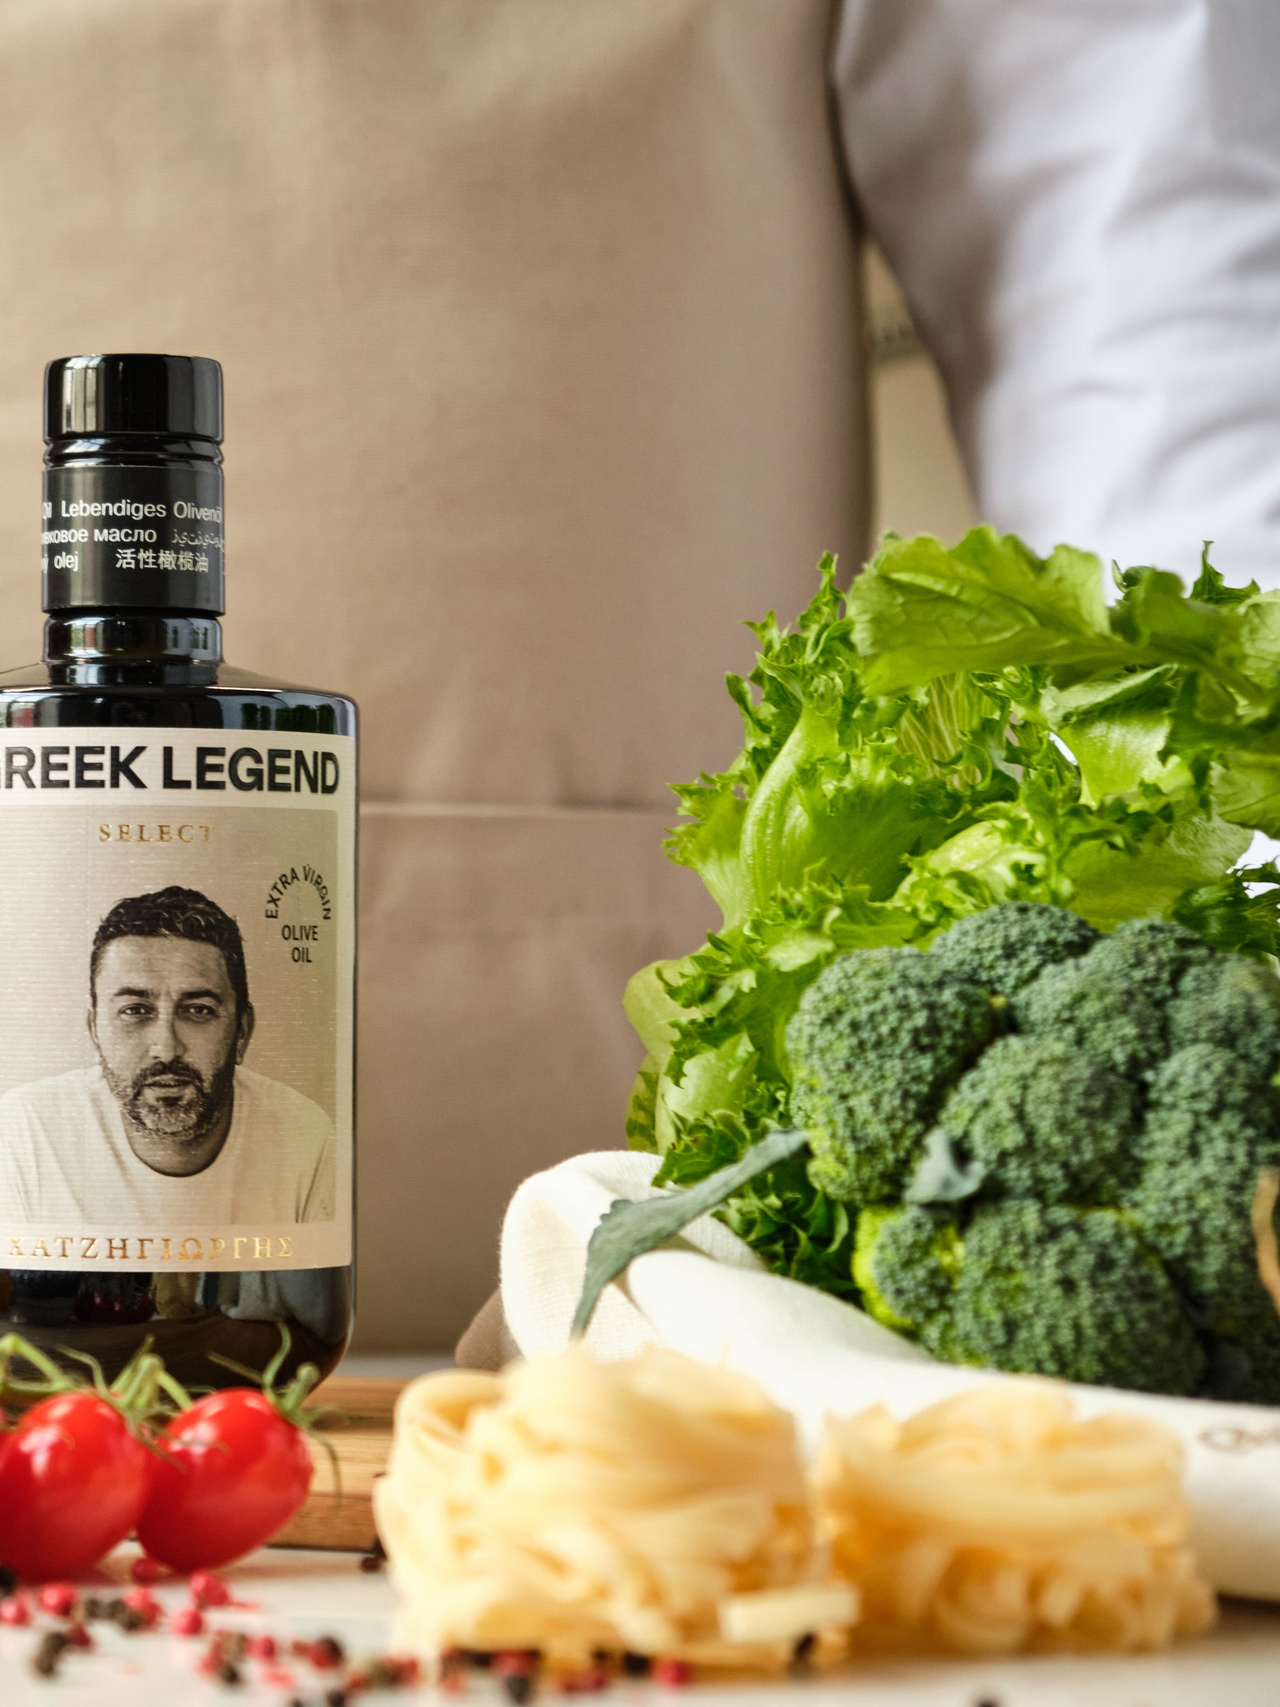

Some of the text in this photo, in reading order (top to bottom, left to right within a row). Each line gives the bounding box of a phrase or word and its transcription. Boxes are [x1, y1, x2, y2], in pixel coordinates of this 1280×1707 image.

[61, 499, 167, 521] Lebendiges
[93, 528, 157, 543] масло
[54, 551, 79, 572] olej
[115, 548, 209, 573] 活性橄榄油
[162, 746, 340, 794] LEGEND
[98, 823, 215, 843] SELECT
[265, 865, 331, 920] EXTRA VIRGIN
[281, 924, 319, 941] OLIVE
[291, 946, 313, 963] OIL
